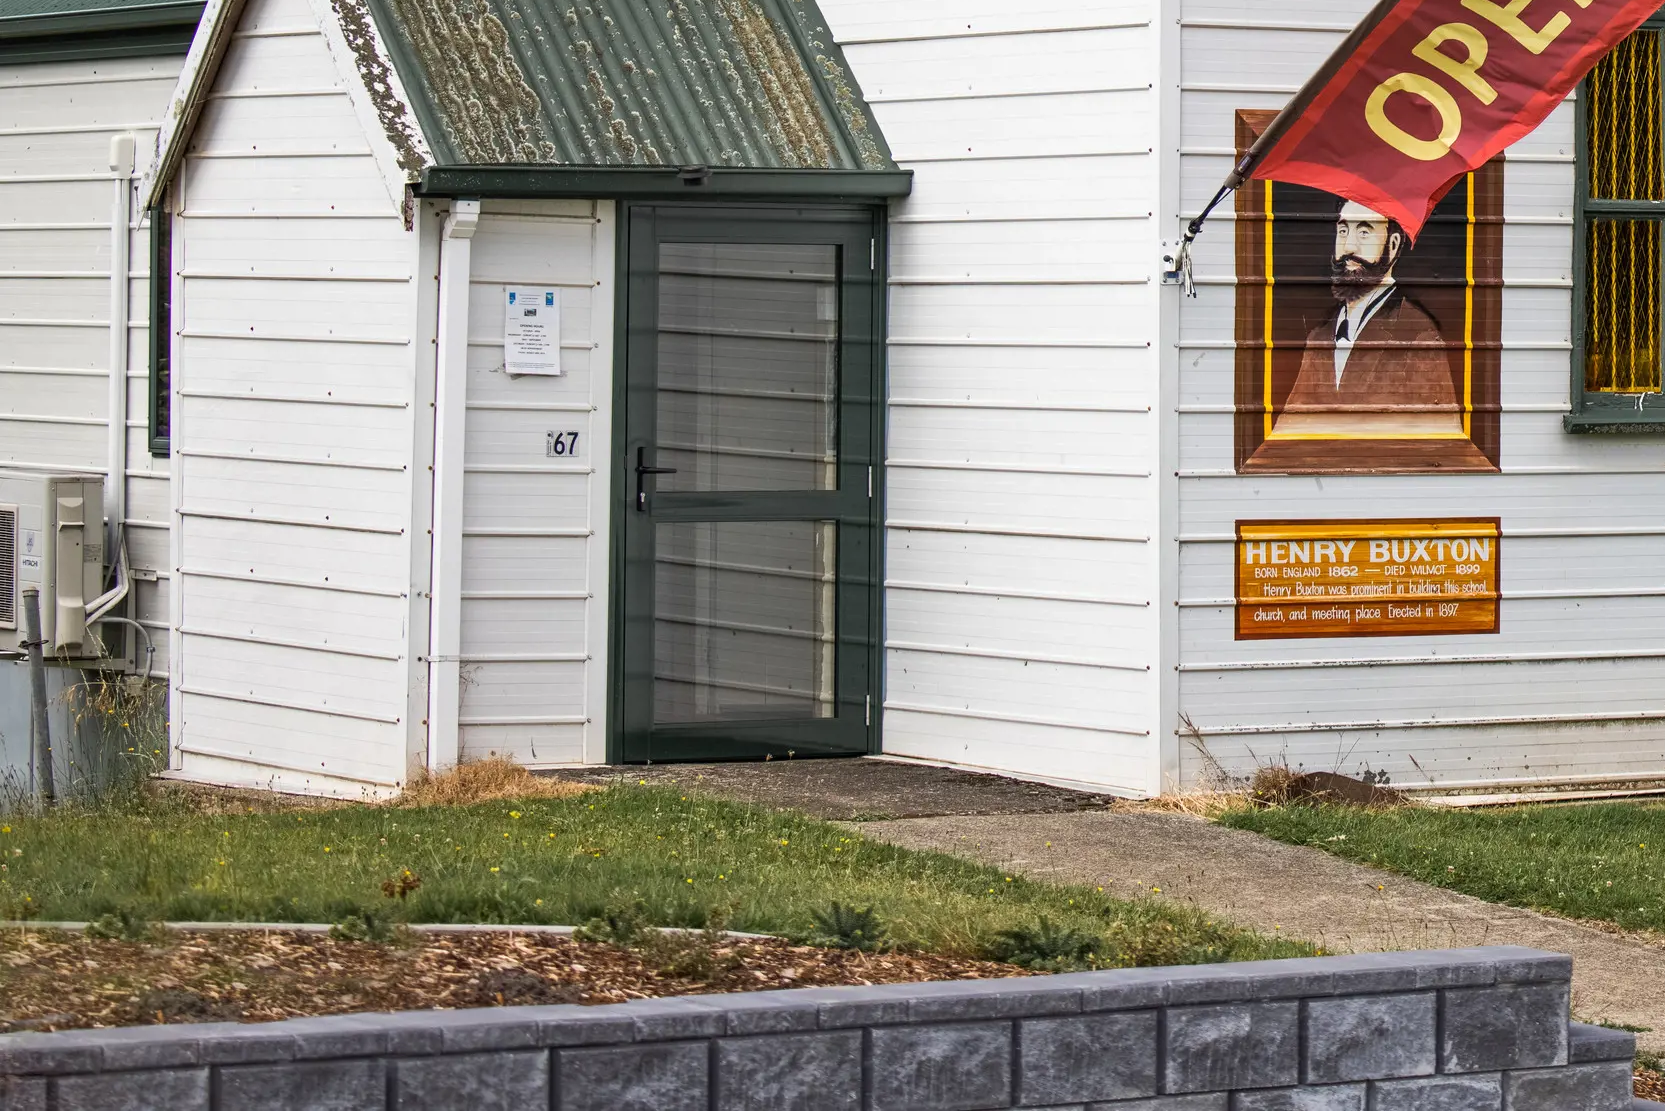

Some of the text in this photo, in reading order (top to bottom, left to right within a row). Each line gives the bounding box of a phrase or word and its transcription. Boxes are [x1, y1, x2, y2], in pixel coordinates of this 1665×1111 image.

[554, 431, 579, 455] 67
[1245, 538, 1490, 565] HENRY BUXTON
[1254, 567, 1278, 579] BORN
[1283, 567, 1321, 578] ENGLAND
[1328, 565, 1359, 577] 1862
[1384, 565, 1406, 576] DIED
[1410, 564, 1448, 576] WILMOT
[1455, 564, 1481, 575] 1899
[1263, 582, 1292, 598] Henry
[1296, 581, 1325, 596] Buxton
[1328, 586, 1347, 595] was
[1351, 580, 1393, 597] prominent
[1396, 579, 1405, 594] in
[1409, 578, 1441, 596] building
[1444, 578, 1459, 594] this
[1254, 607, 1286, 623] church,
[1289, 606, 1307, 620] and
[1312, 605, 1350, 624] meeting
[1388, 603, 1421, 618] Erected
[1425, 603, 1434, 617] in
